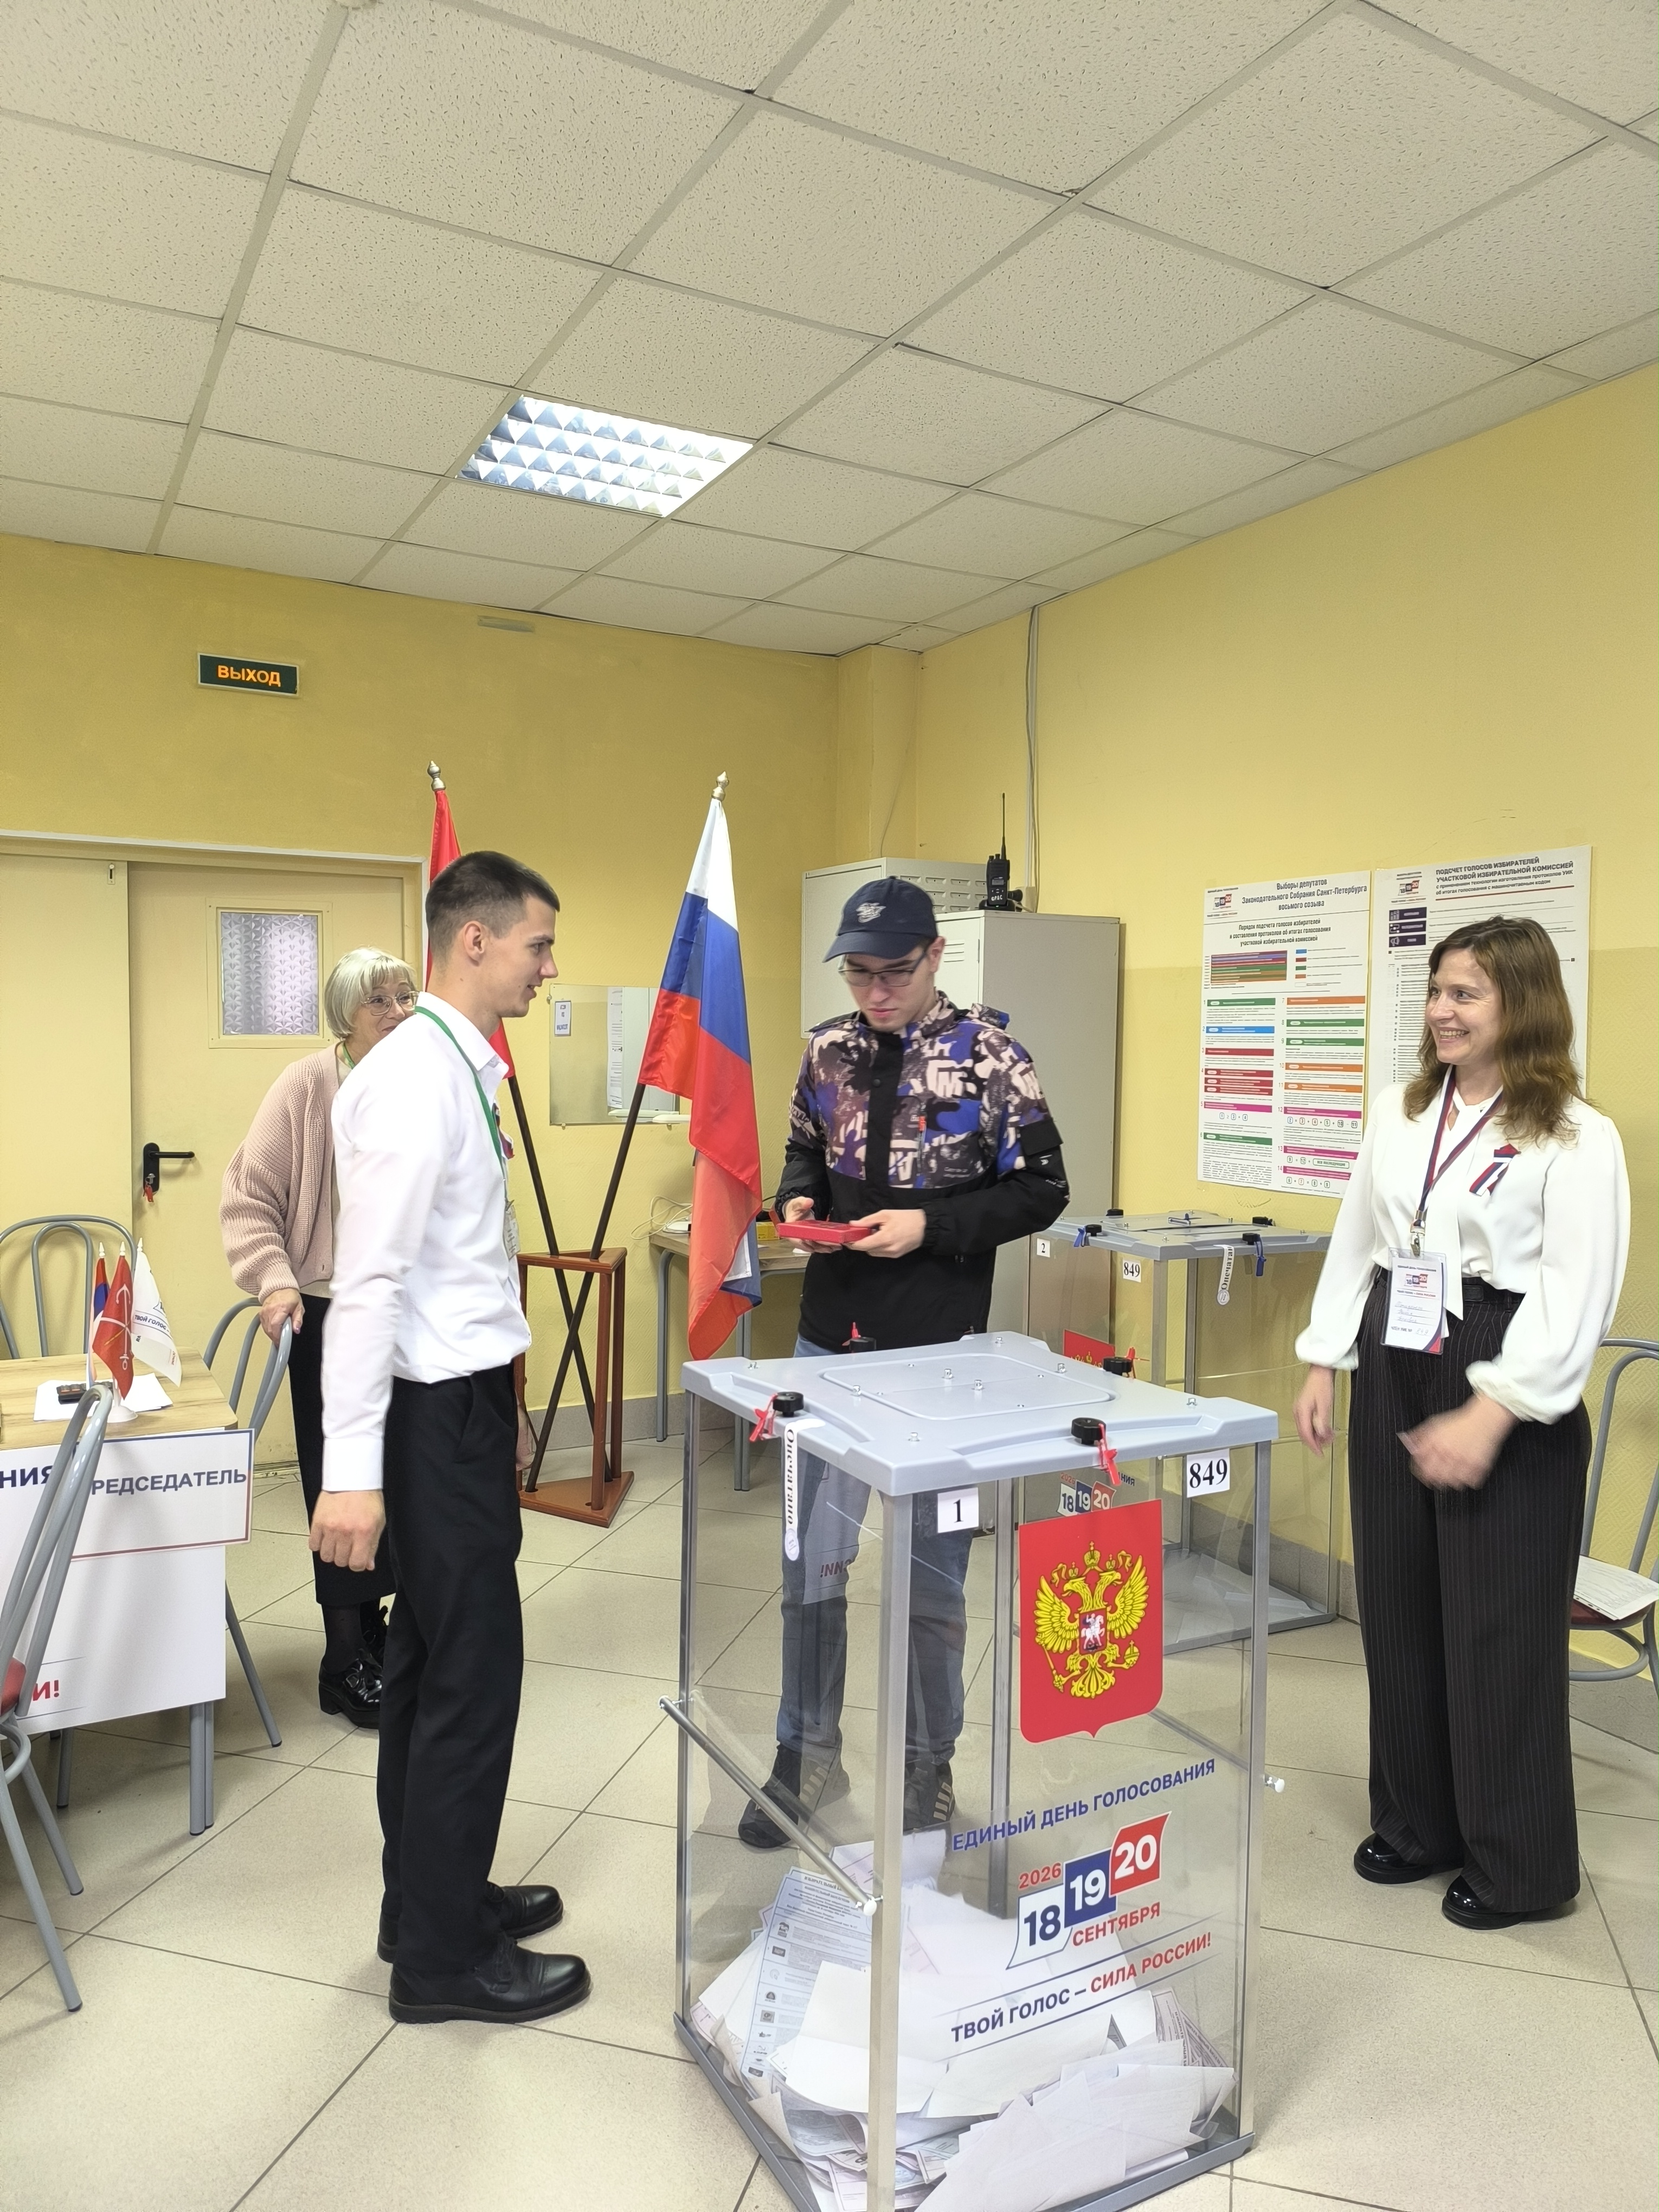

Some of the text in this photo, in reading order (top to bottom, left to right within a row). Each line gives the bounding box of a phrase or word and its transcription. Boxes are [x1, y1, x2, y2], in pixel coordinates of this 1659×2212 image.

[218, 665, 281, 687] ВЫХОД
[1437, 861, 1573, 882] УЧАСТКОВОЙ ИЗБИРАТЕЛЬНОЙ КОМИССИЕЙ
[1464, 863, 1492, 872] ГОЛОСОВ
[1494, 857, 1539, 868] ИЗБИРАТЕЛЕЙ
[1242, 885, 1367, 904] Законодательного Собрания Санкт-Петербурга
[1300, 879, 1327, 889] депутатов
[1278, 902, 1303, 910] восьмого
[1041, 1243, 1045, 1253] 2
[1123, 1262, 1140, 1278] 849
[148, 1317, 166, 1330] ГОЛОС
[92, 1469, 247, 1496] РЕДСЕДАТЕЛЬ
[787, 1429, 795, 1525] Опечатано
[1189, 1458, 1228, 1489] 849
[953, 1499, 962, 1523] 1
[1062, 1489, 1110, 1513] 18 19 20
[953, 1758, 1215, 1851] ЕДИНЫЙ ДЕНЬ ГОЛОСОВАНИЯ
[1019, 1862, 1062, 1889] 2026
[1024, 1834, 1158, 1947] 18 19 20
[1072, 1901, 1160, 1947] СЕНТЯБРЯ
[951, 2007, 1004, 2043] ТВОЙ
[1009, 1988, 1070, 2024] ГОЛОС
[1091, 1963, 1137, 1993] СИЛА
[1141, 1932, 1212, 1974] РОССИИ!
